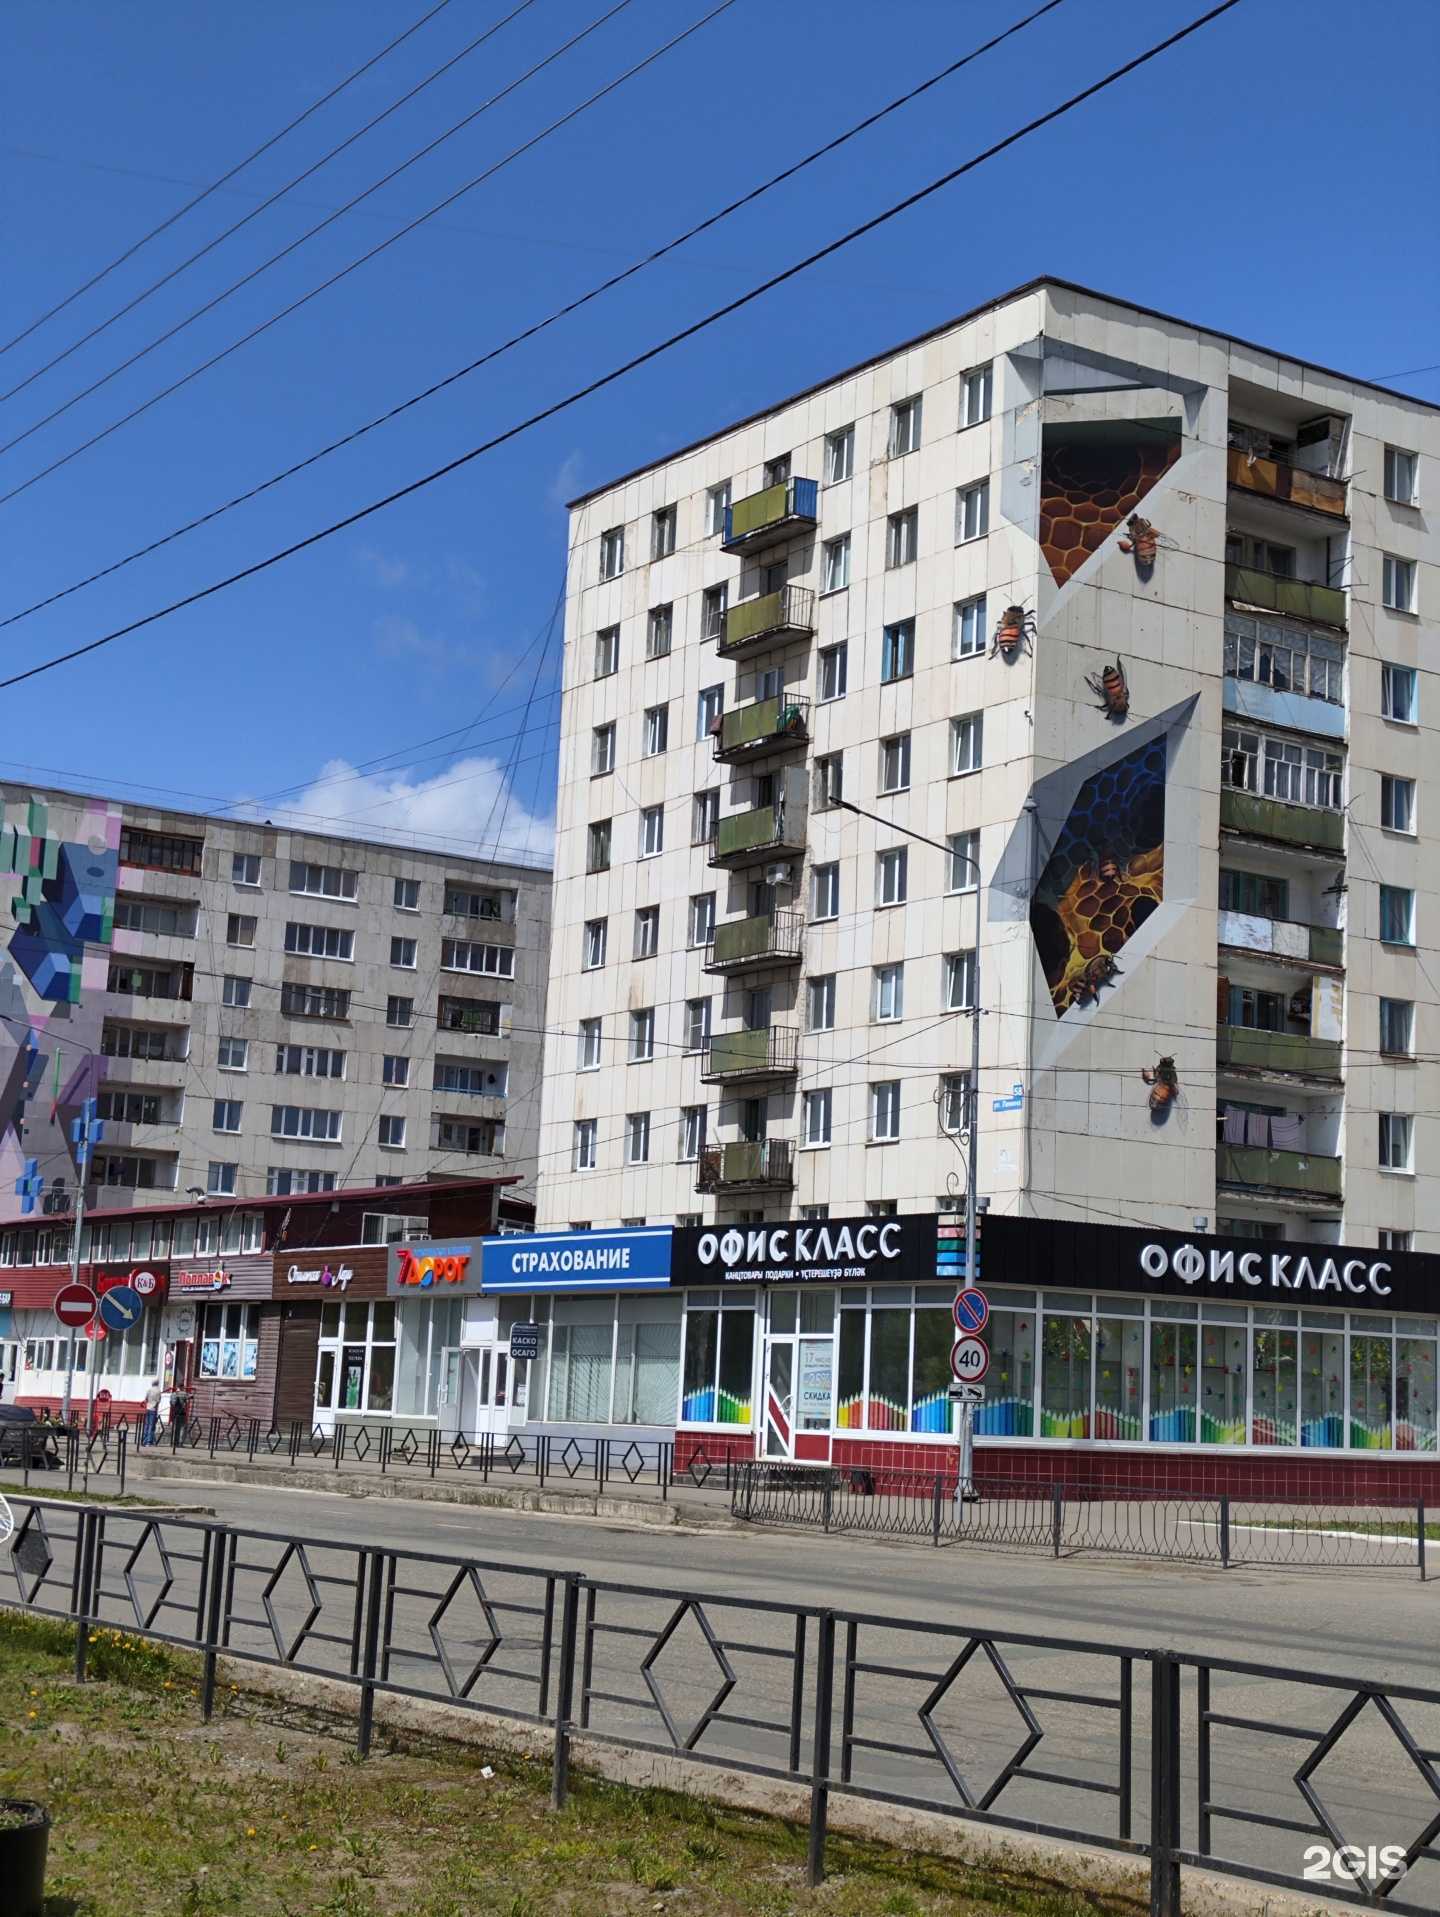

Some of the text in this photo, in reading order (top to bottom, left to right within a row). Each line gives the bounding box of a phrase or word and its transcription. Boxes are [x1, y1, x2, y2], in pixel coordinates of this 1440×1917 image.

[698, 1223, 901, 1267] ОФИС КЛАСС
[512, 1248, 631, 1273] СТРАХОВАНИЕ
[725, 1269, 763, 1281] КАНЦТОВАРЫ
[765, 1268, 794, 1280] ПОДАРКИ
[1141, 1244, 1392, 1295] ОФИС КЛАСС
[512, 1337, 537, 1345] КАСКО
[512, 1348, 536, 1357] ОСАГО
[959, 1350, 980, 1367] 40
[804, 1391, 832, 1401] СКИДКА
